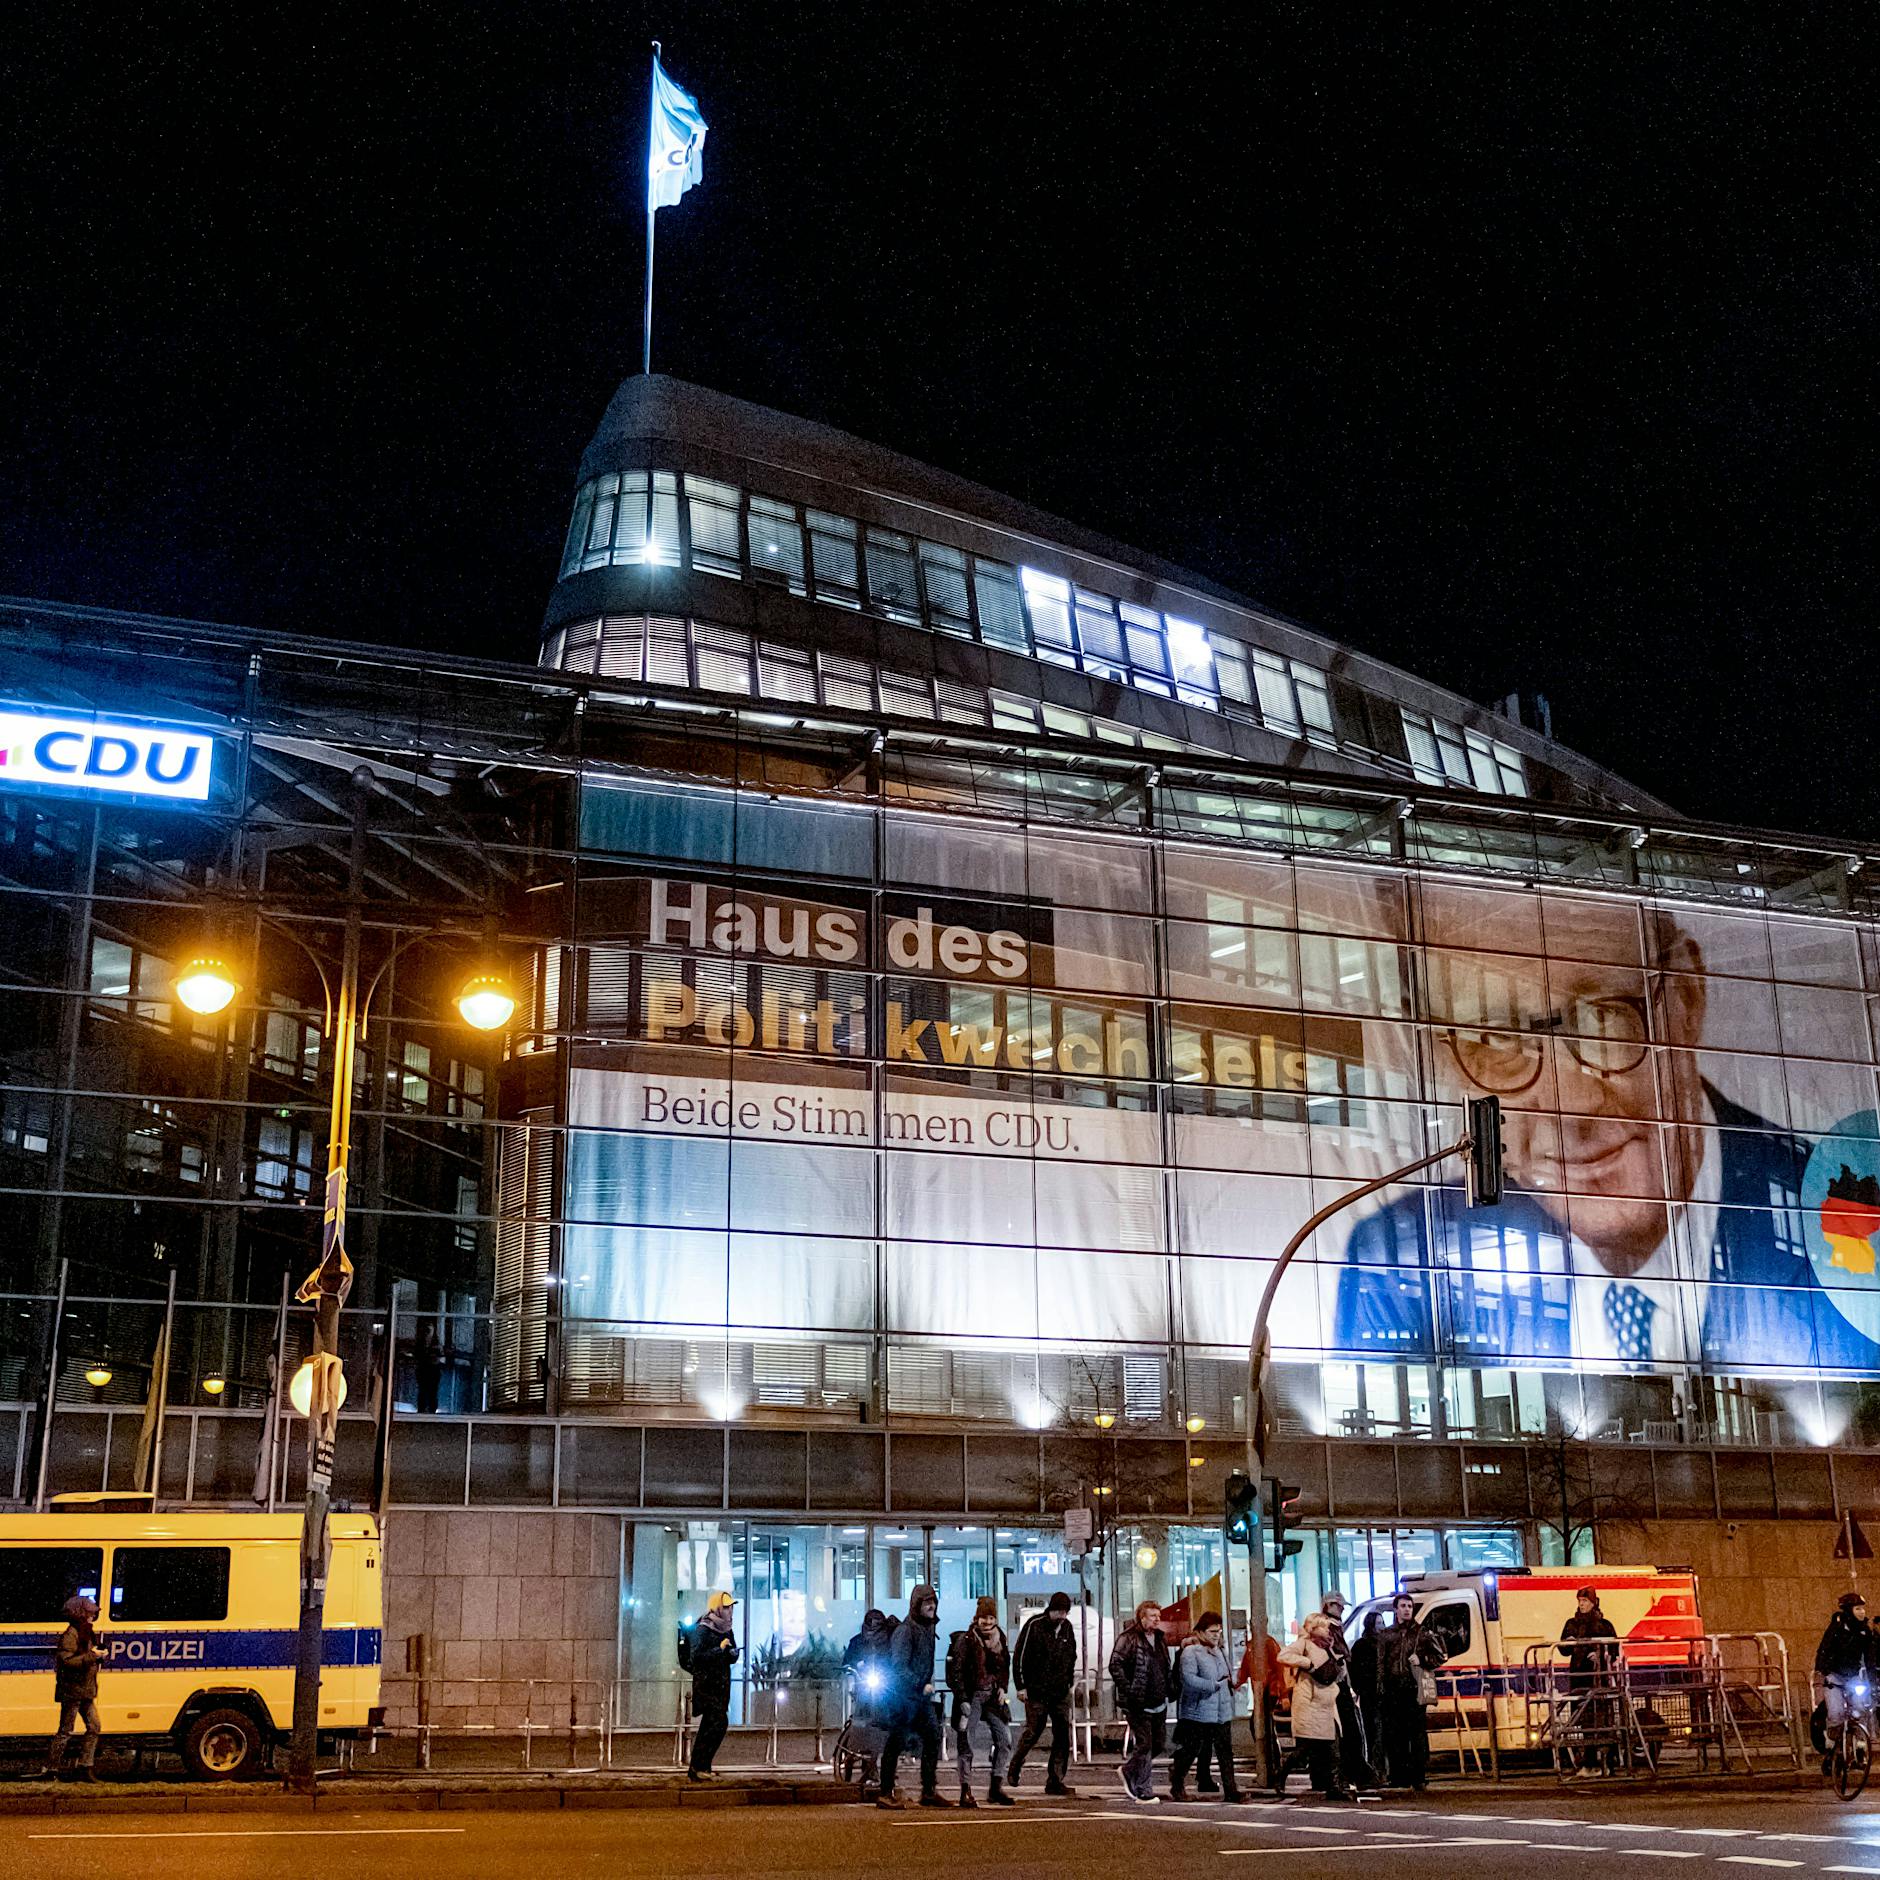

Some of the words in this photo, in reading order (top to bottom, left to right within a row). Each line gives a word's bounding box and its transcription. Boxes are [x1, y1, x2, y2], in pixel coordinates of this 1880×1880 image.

[34, 731, 201, 785] CDU
[650, 879, 859, 962] Haus
[887, 907, 1028, 979] des
[646, 979, 1309, 1092] Politikwechsels
[641, 1086, 761, 1130] Beide
[772, 1096, 975, 1145] Stimmen
[985, 1111, 1080, 1152] CDU.
[110, 1640, 204, 1661] POLIZEI
